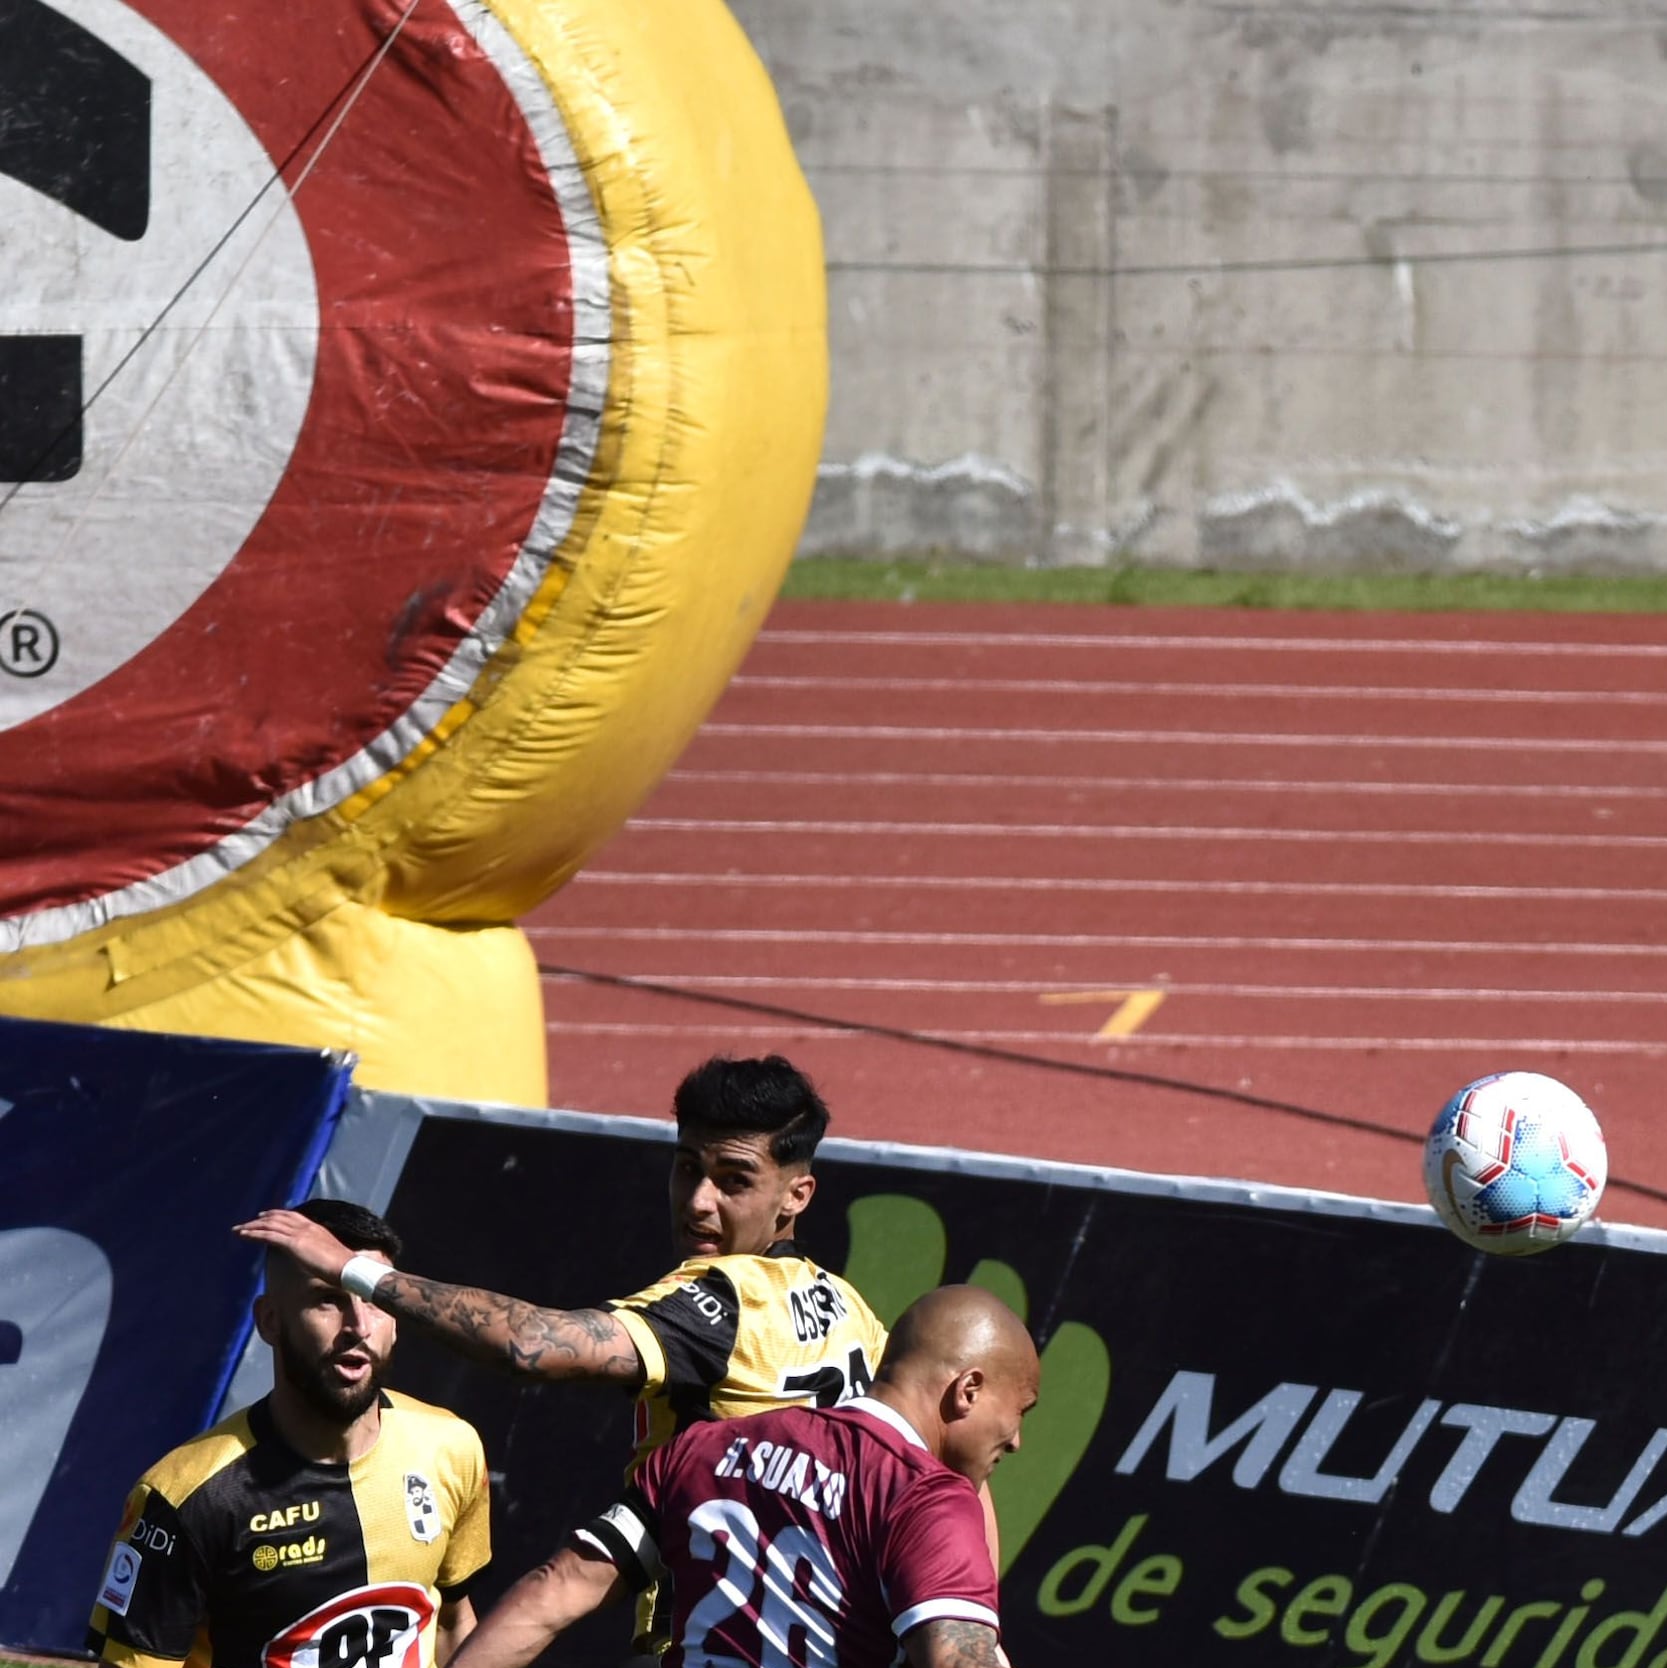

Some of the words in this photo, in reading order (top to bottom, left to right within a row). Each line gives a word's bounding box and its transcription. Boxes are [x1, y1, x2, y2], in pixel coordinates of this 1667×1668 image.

[250, 1501, 320, 1533] CAFU
[131, 1518, 176, 1557] DiDi
[1036, 1514, 1183, 1625] de
